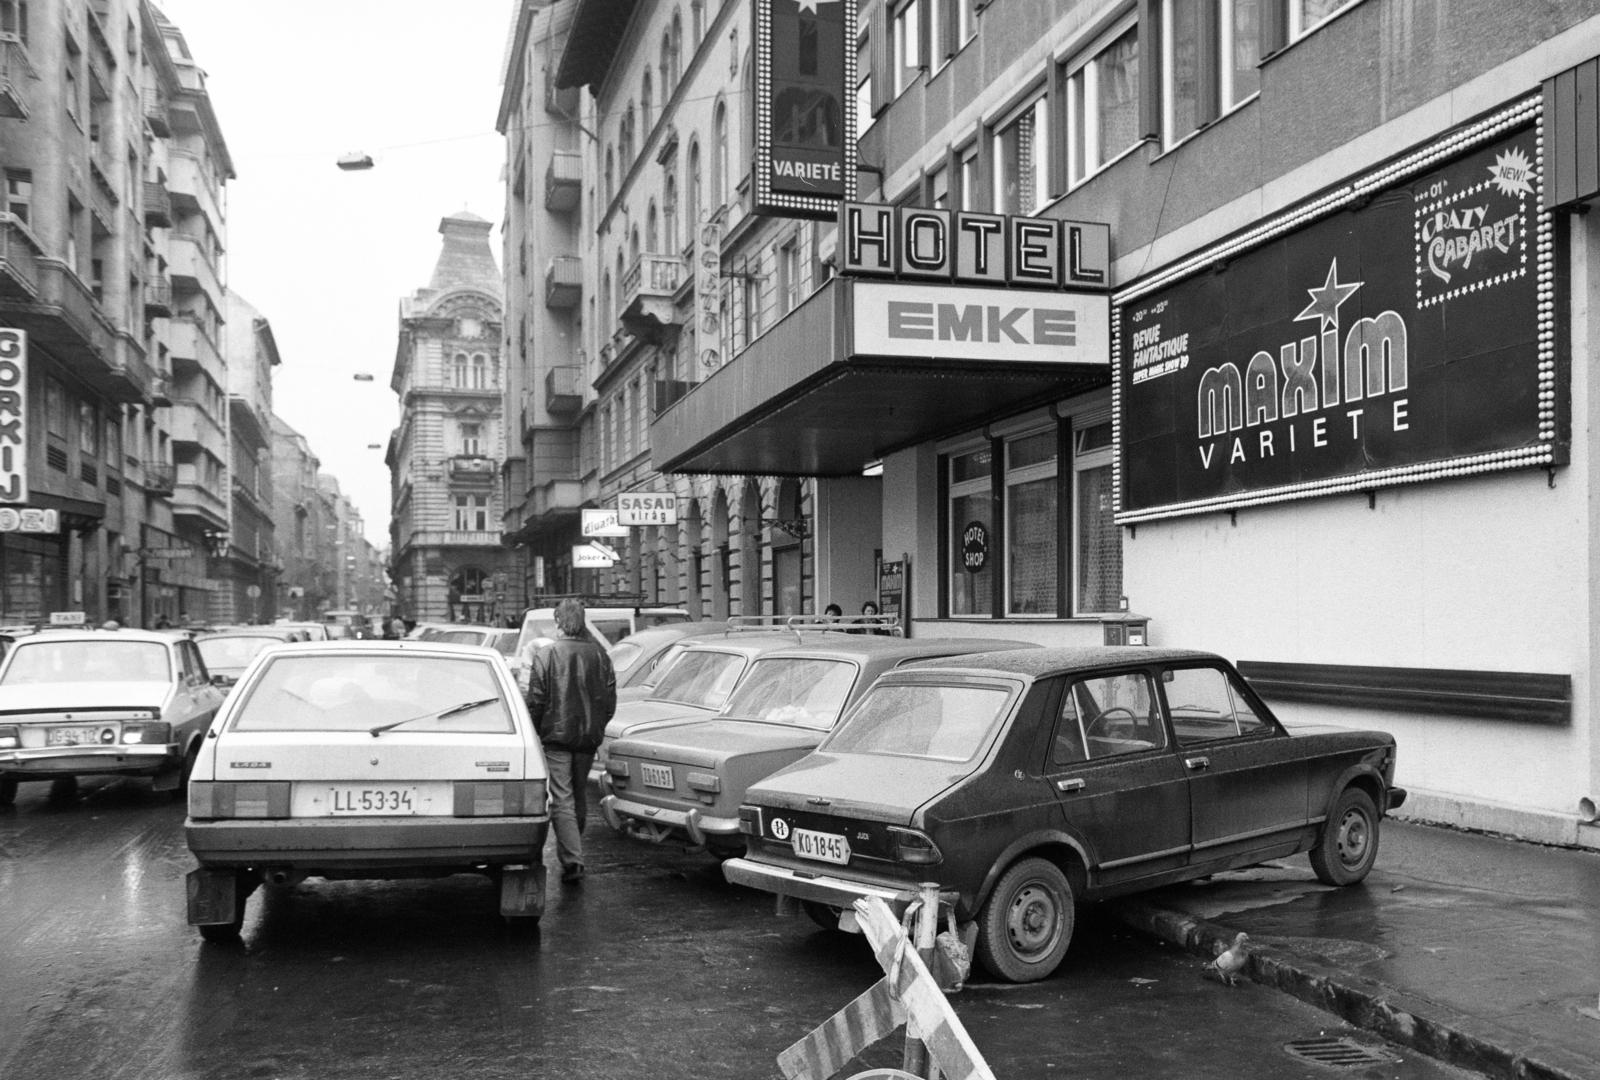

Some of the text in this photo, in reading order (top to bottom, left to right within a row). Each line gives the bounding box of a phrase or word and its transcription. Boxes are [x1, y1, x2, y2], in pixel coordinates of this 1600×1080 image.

[1499, 166, 1526, 183] NEW!
[1422, 203, 1490, 243] CRAZY
[849, 208, 1104, 283] HOTEL
[1428, 213, 1519, 284] CABARET
[888, 301, 1076, 346] EMKE
[1133, 324, 1161, 351] REVUE
[1133, 332, 1189, 369] FANTASTIQUE
[0, 331, 22, 500] GORKIJ
[1199, 399, 1409, 470] VARIETE
[621, 497, 675, 510] SASAD
[631, 510, 667, 523] virág
[963, 526, 985, 547] HOTEL
[965, 551, 984, 567] SHOP
[775, 820, 785, 836] H
